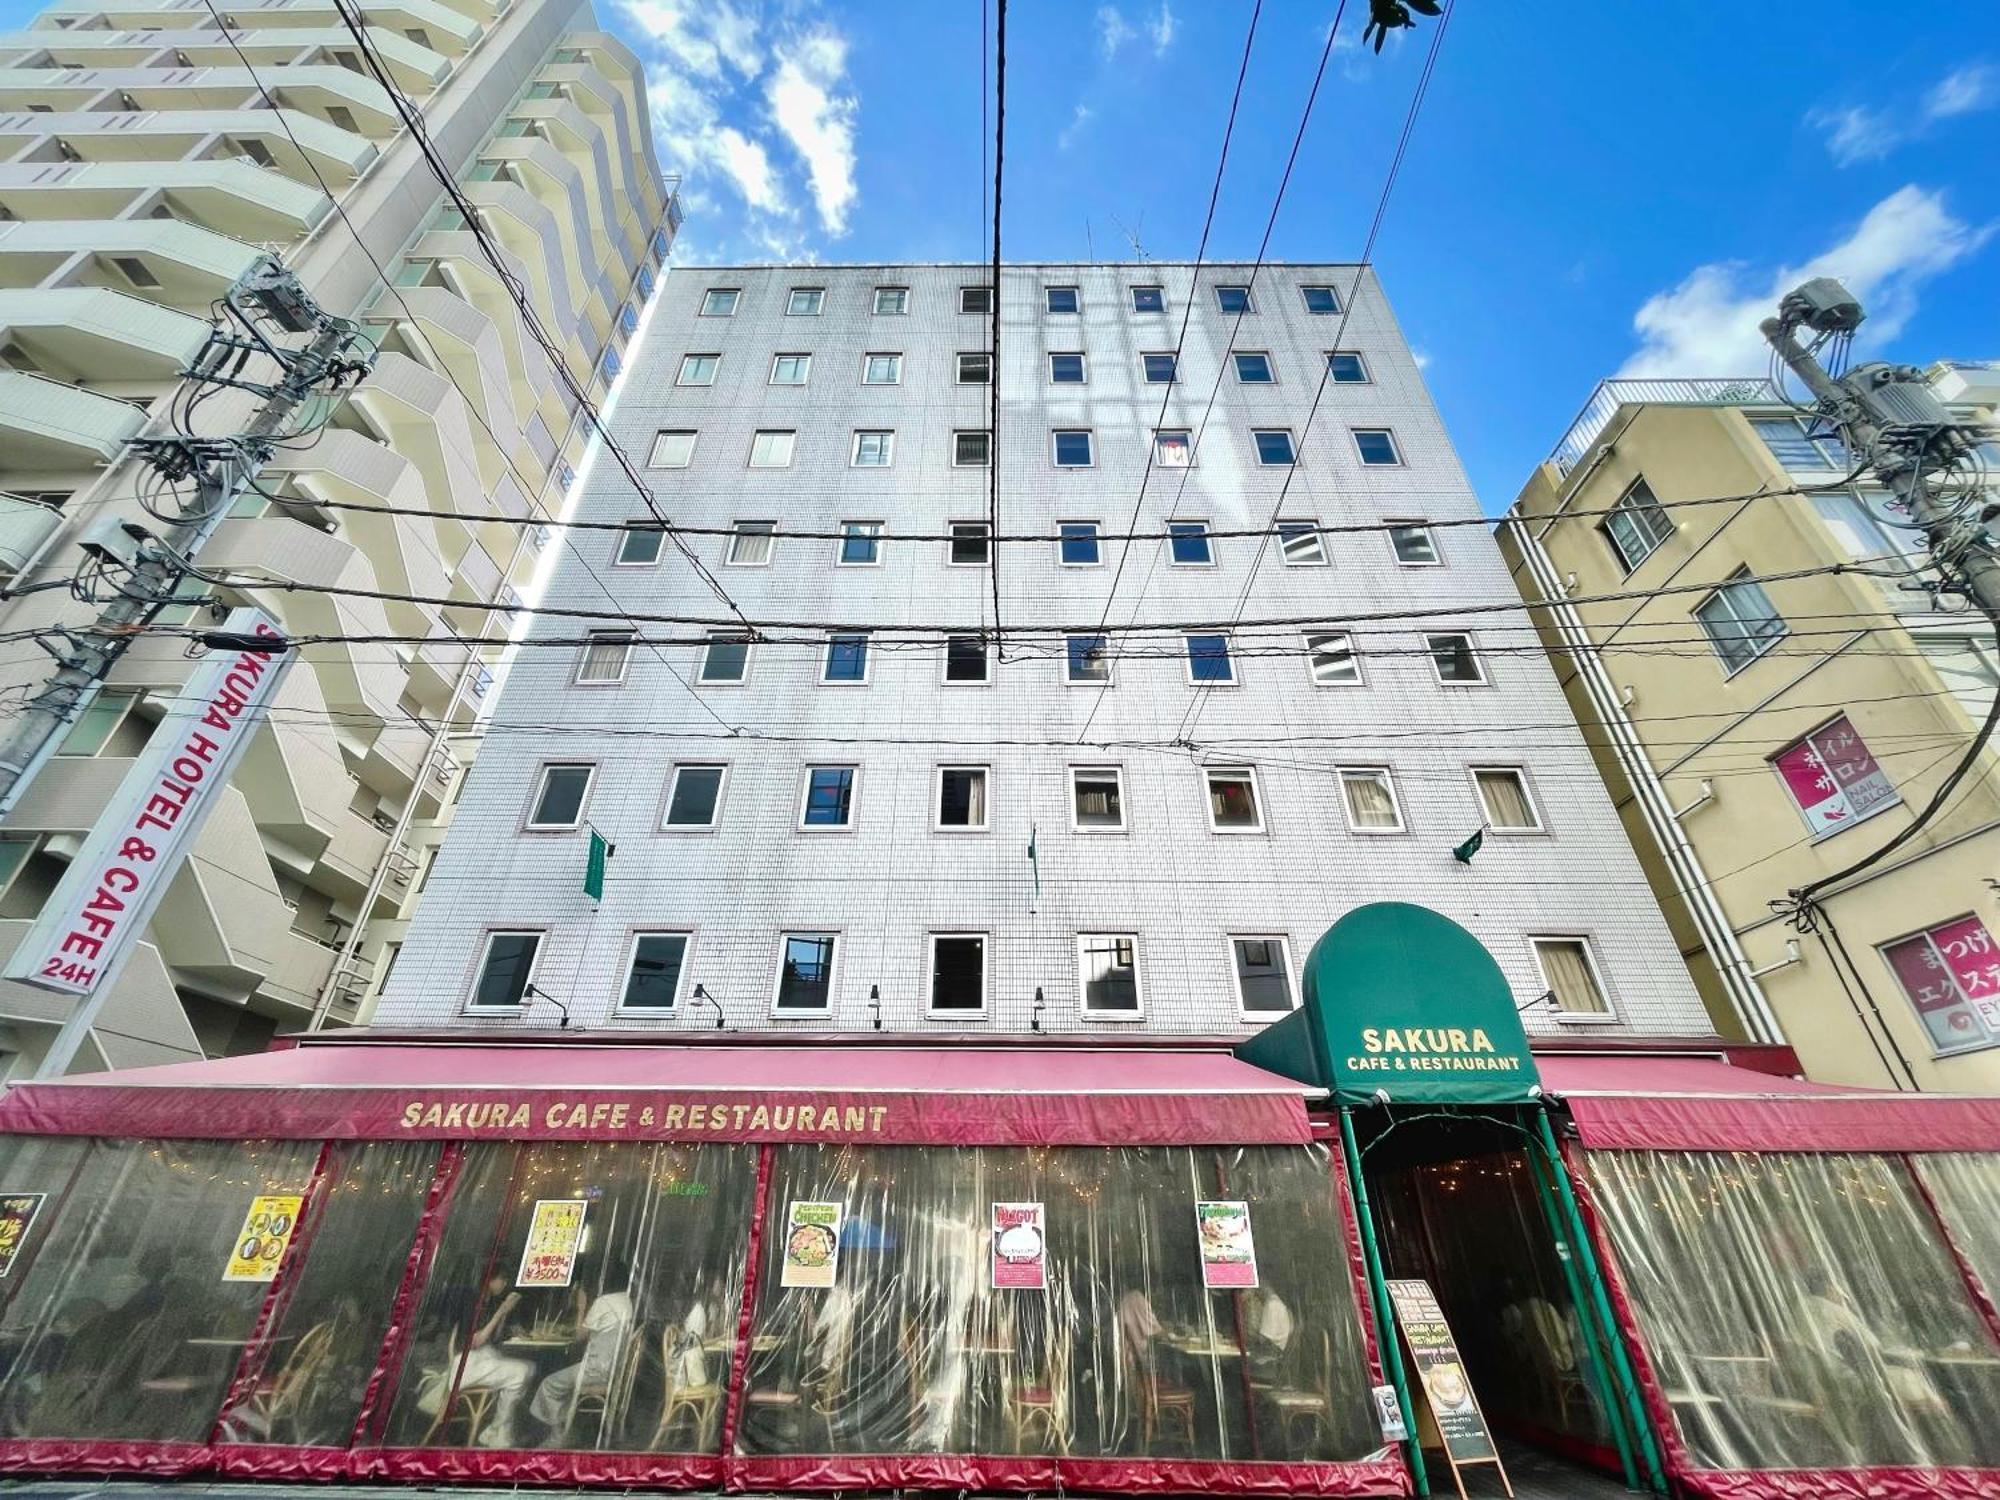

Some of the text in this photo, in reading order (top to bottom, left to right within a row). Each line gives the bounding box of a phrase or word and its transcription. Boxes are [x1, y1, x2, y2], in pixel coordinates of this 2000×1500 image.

[135, 732, 219, 830] HOTEL
[1850, 780, 1880, 800] NAIL
[118, 836, 156, 862] &
[61, 867, 139, 960] CAFE
[1920, 928, 1990, 969] まつげ
[41, 957, 96, 986] 24H
[1363, 1029, 1495, 1053] SAKURA
[1347, 1057, 1520, 1071] CAFE & RESTAURANT
[400, 1103, 888, 1132] SAKURA CAFE & RESTAURANT
